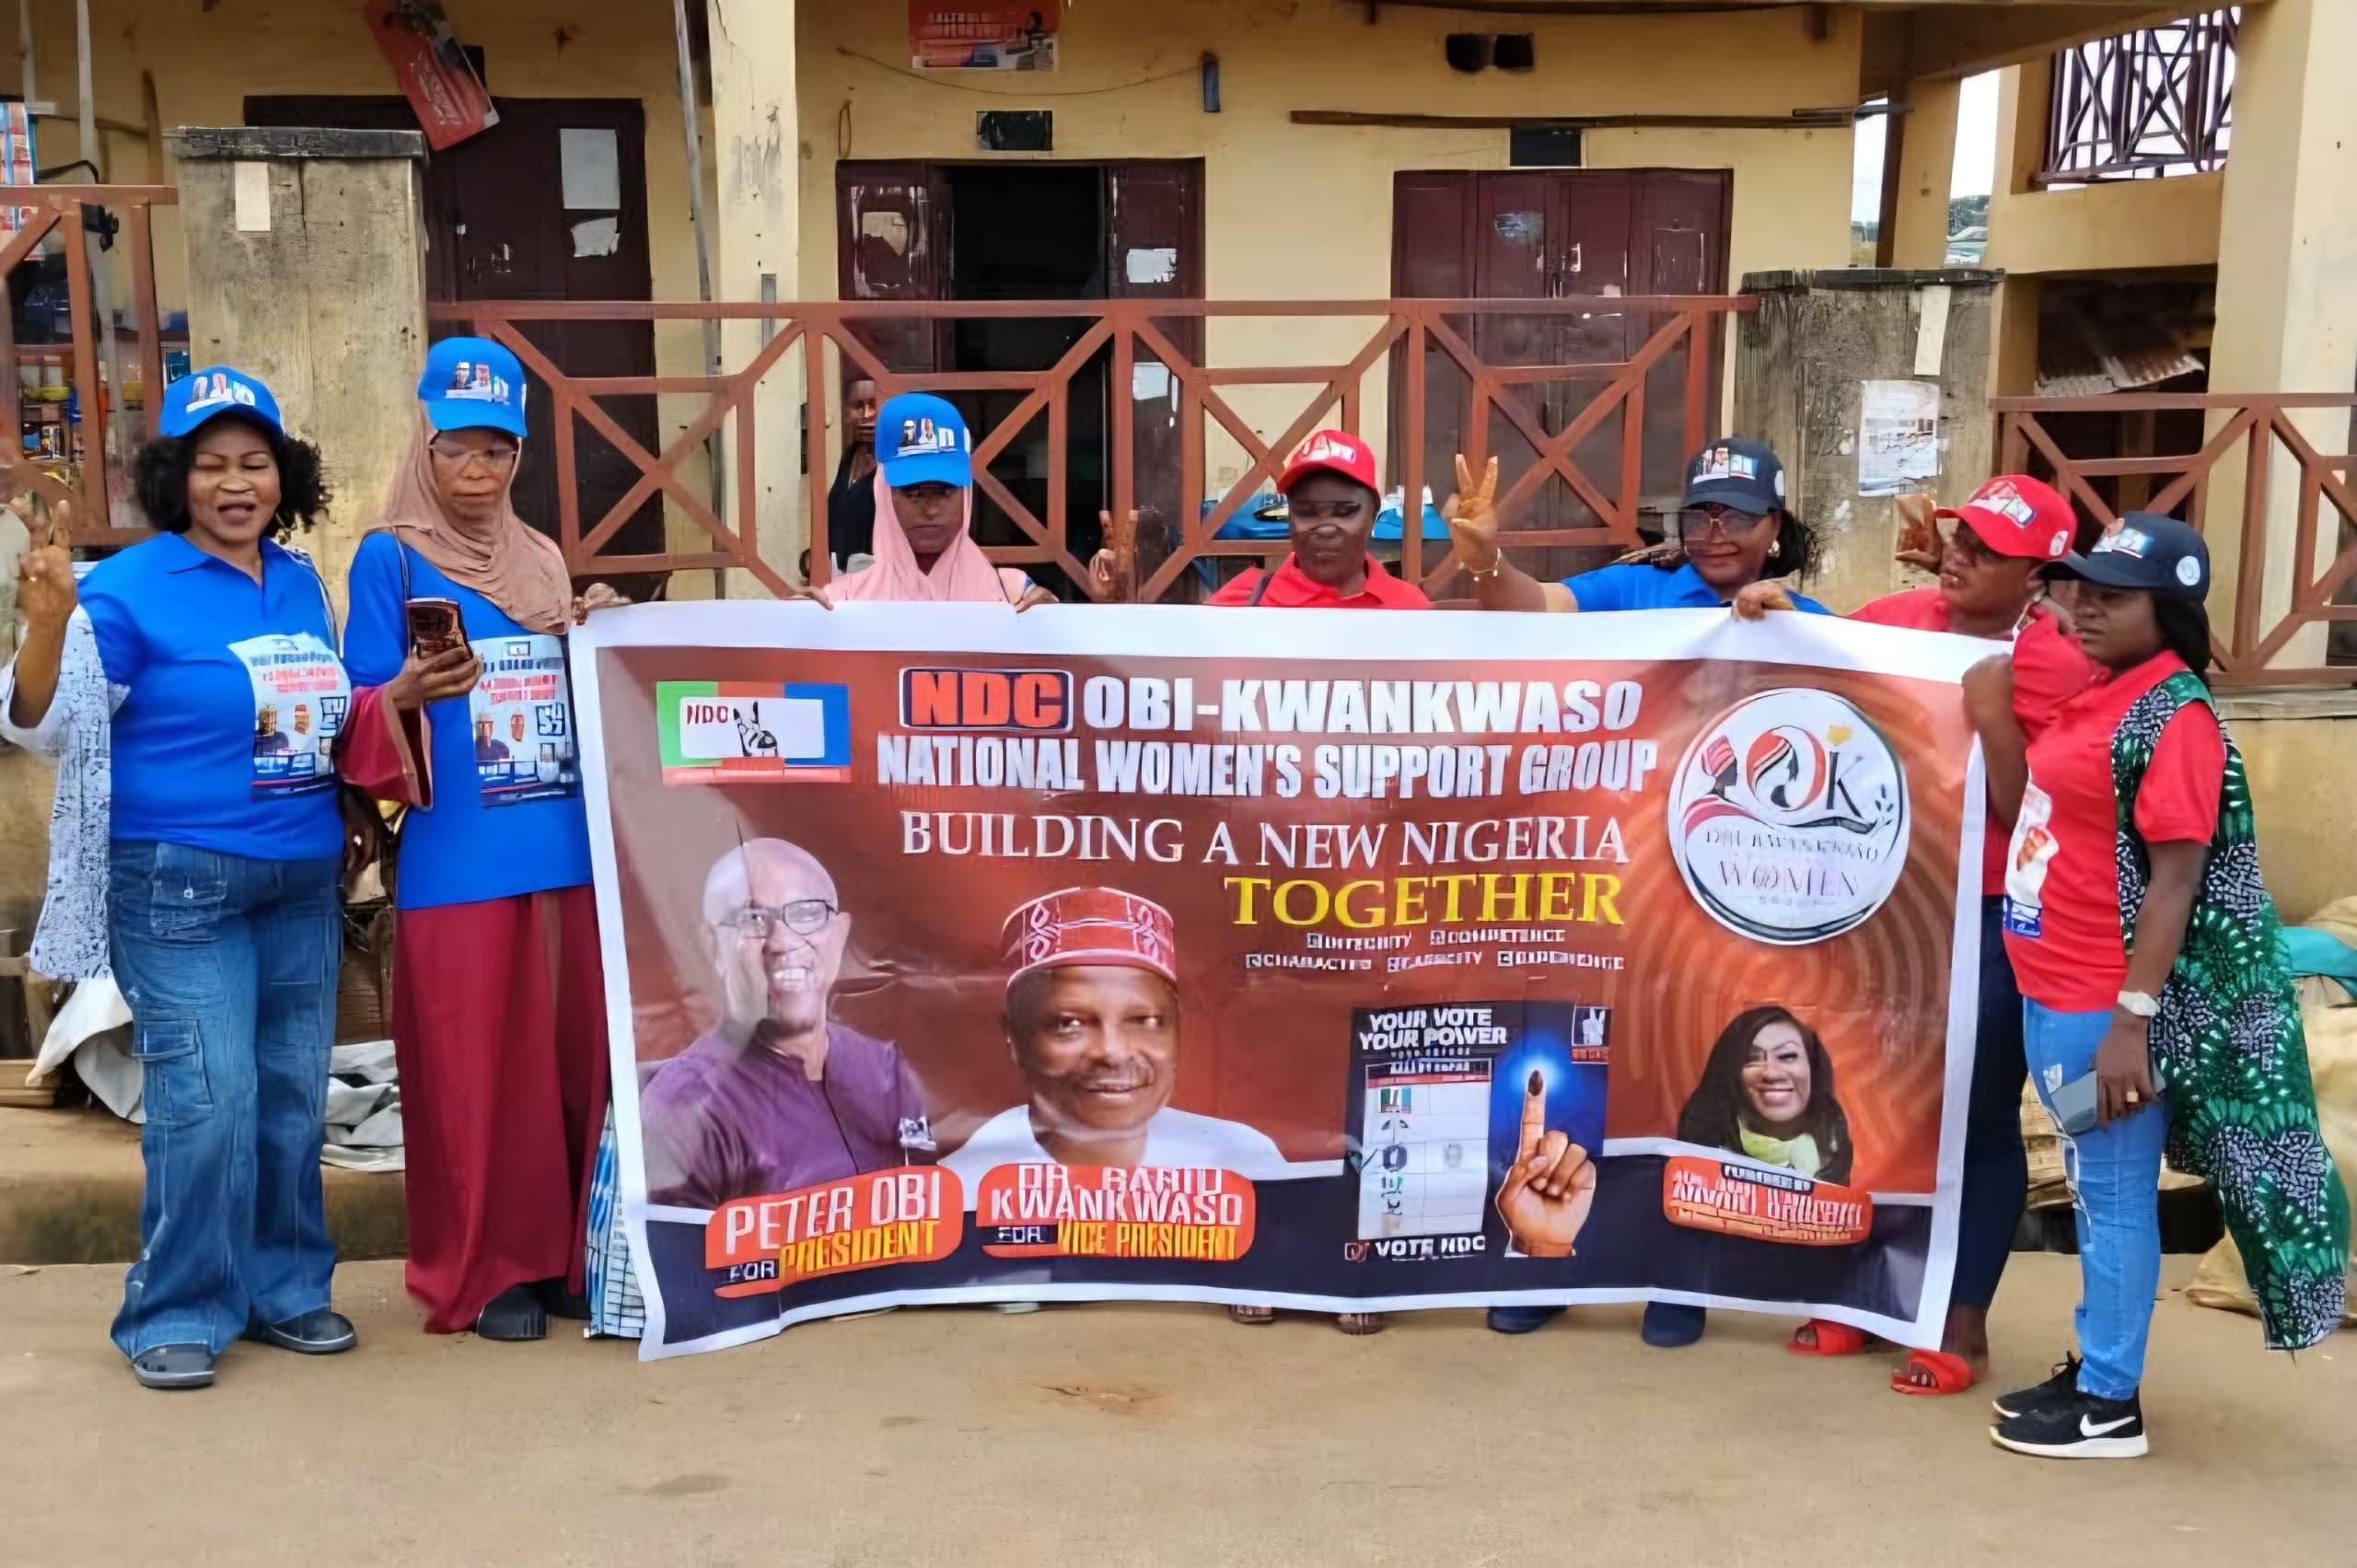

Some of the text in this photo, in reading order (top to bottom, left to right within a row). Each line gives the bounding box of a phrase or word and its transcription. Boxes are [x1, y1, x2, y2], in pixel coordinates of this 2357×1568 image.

[911, 671, 1643, 734] NDC OBI-KWANKWASO
[877, 734, 1658, 799] NATIONAL WOMEN'S SUPPORT GROUP
[900, 810, 1630, 869] BUILDING A NEW NIGERIA
[1224, 871, 1624, 929] TOGETHER
[1359, 1027, 1507, 1051] YOUR POWER
[1369, 1007, 1492, 1032] YOUR VOTE
[725, 1170, 940, 1256] PETER OBI
[991, 1186, 1243, 1225] KWANKWASO
[729, 1220, 941, 1282] FOR PRESIDENT
[1058, 1219, 1108, 1254] VICE
[1376, 1238, 1434, 1258] VOTE
